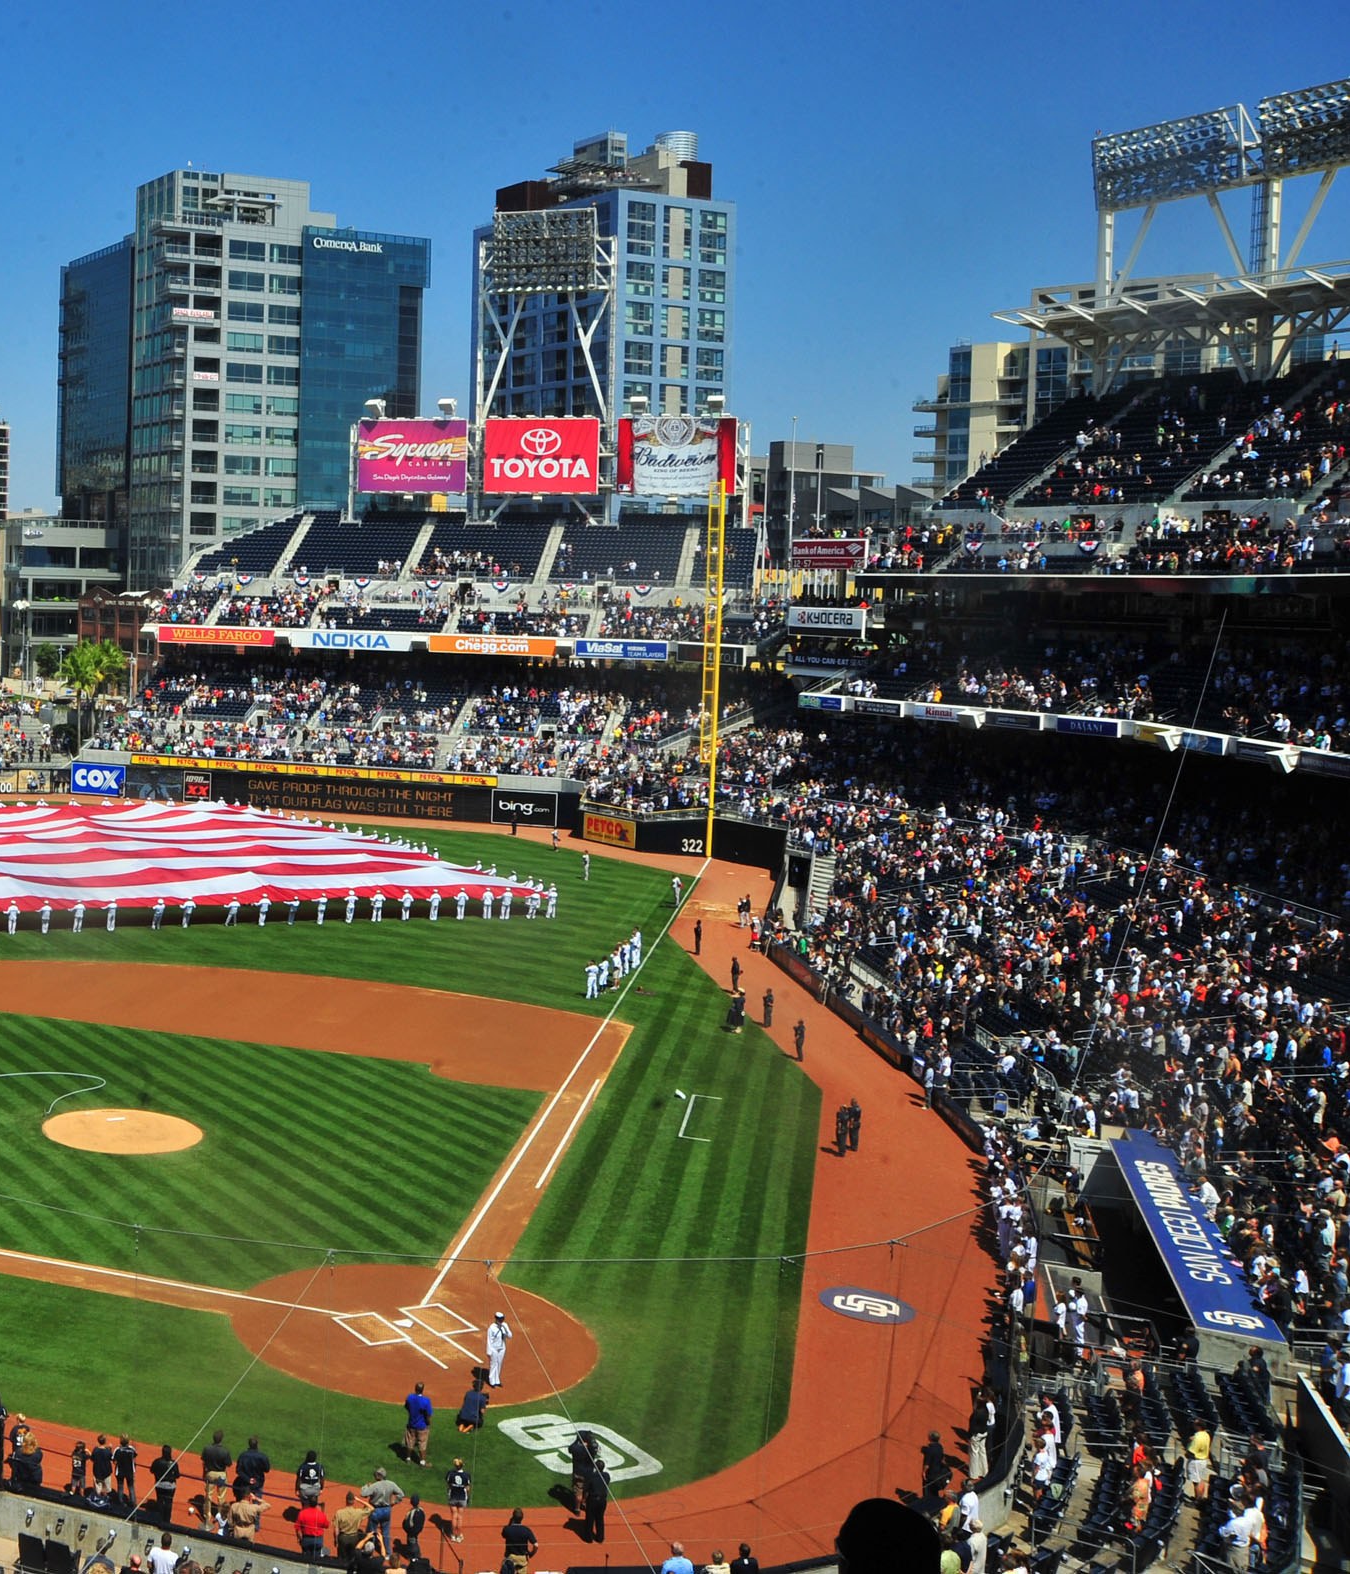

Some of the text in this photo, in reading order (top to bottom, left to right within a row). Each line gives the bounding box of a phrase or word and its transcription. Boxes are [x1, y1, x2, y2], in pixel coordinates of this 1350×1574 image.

[359, 241, 383, 253] Bank
[363, 434, 460, 467] Sycuan
[634, 446, 717, 468] Budweiser
[491, 458, 590, 478] TOYOTA
[793, 546, 845, 556] Bank of America
[807, 611, 853, 626] KYOCERA
[172, 628, 262, 642] WELLS FARGO
[312, 632, 390, 649] NOKIA
[455, 639, 529, 654] Chegg.com
[586, 642, 624, 654] ViaSat
[925, 707, 952, 718] Rinnai
[1071, 721, 1103, 733] DASANI
[177, 758, 196, 766] PETCO
[74, 768, 120, 790] COX
[420, 774, 440, 782] PETCO
[462, 776, 483, 784] PETCO
[186, 784, 208, 796] XX
[248, 780, 454, 802] GAVE PROOF THROUGH THE NIGHT
[250, 794, 454, 818] THAT OUR FLAG WAS STILL THERE
[499, 800, 550, 816] bing.com
[587, 816, 624, 834] PETCO
[681, 838, 703, 854] 322
[1134, 1160, 1192, 1212] PADRES
[1158, 1210, 1214, 1250] DIEGO
[1178, 1249, 1232, 1286] SAN
